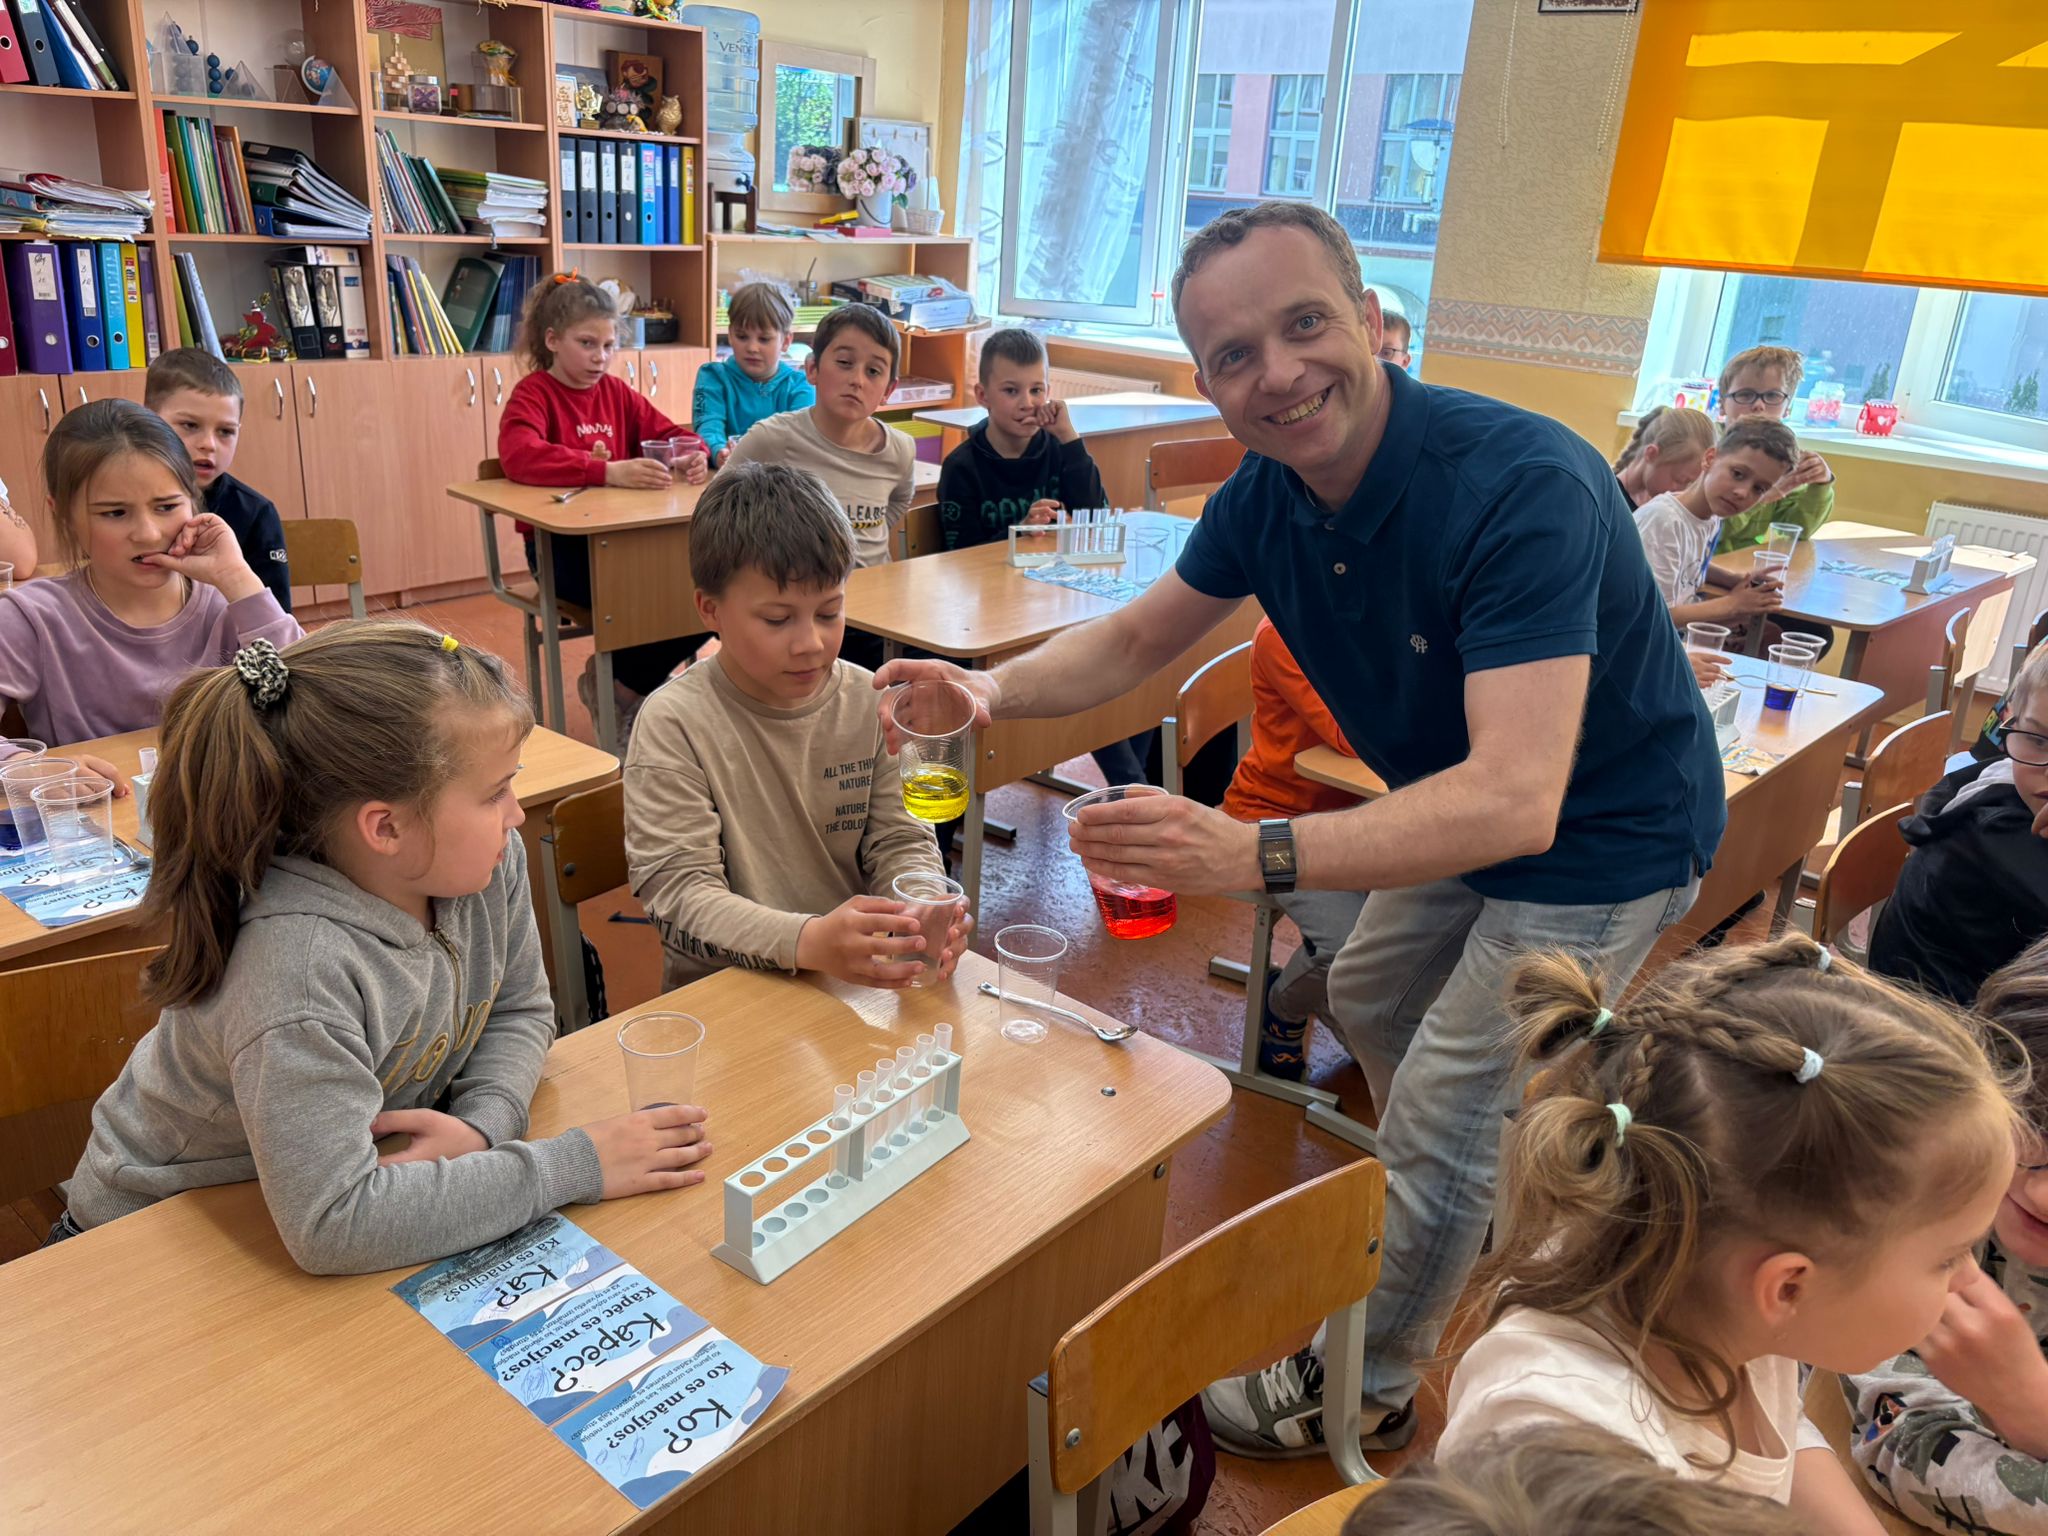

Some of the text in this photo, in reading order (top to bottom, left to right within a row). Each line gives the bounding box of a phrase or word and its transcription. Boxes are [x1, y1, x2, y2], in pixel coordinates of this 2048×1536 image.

[824, 768, 838, 779] ALL
[840, 762, 856, 775] THE
[839, 776, 871, 790] NATURE
[836, 802, 867, 816] NATURE
[825, 824, 840, 834] THE
[83, 887, 138, 909] Ko?
[536, 1237, 560, 1251] Kā
[516, 1250, 534, 1262] es
[443, 1260, 514, 1302] mācījos?
[495, 1264, 558, 1307] Kā?
[502, 1286, 656, 1381] Kāpēc es mācījos?
[550, 1312, 665, 1392] Kāpēc?
[606, 1361, 734, 1448] Ko es mācījos?
[663, 1398, 732, 1454] Ko?
